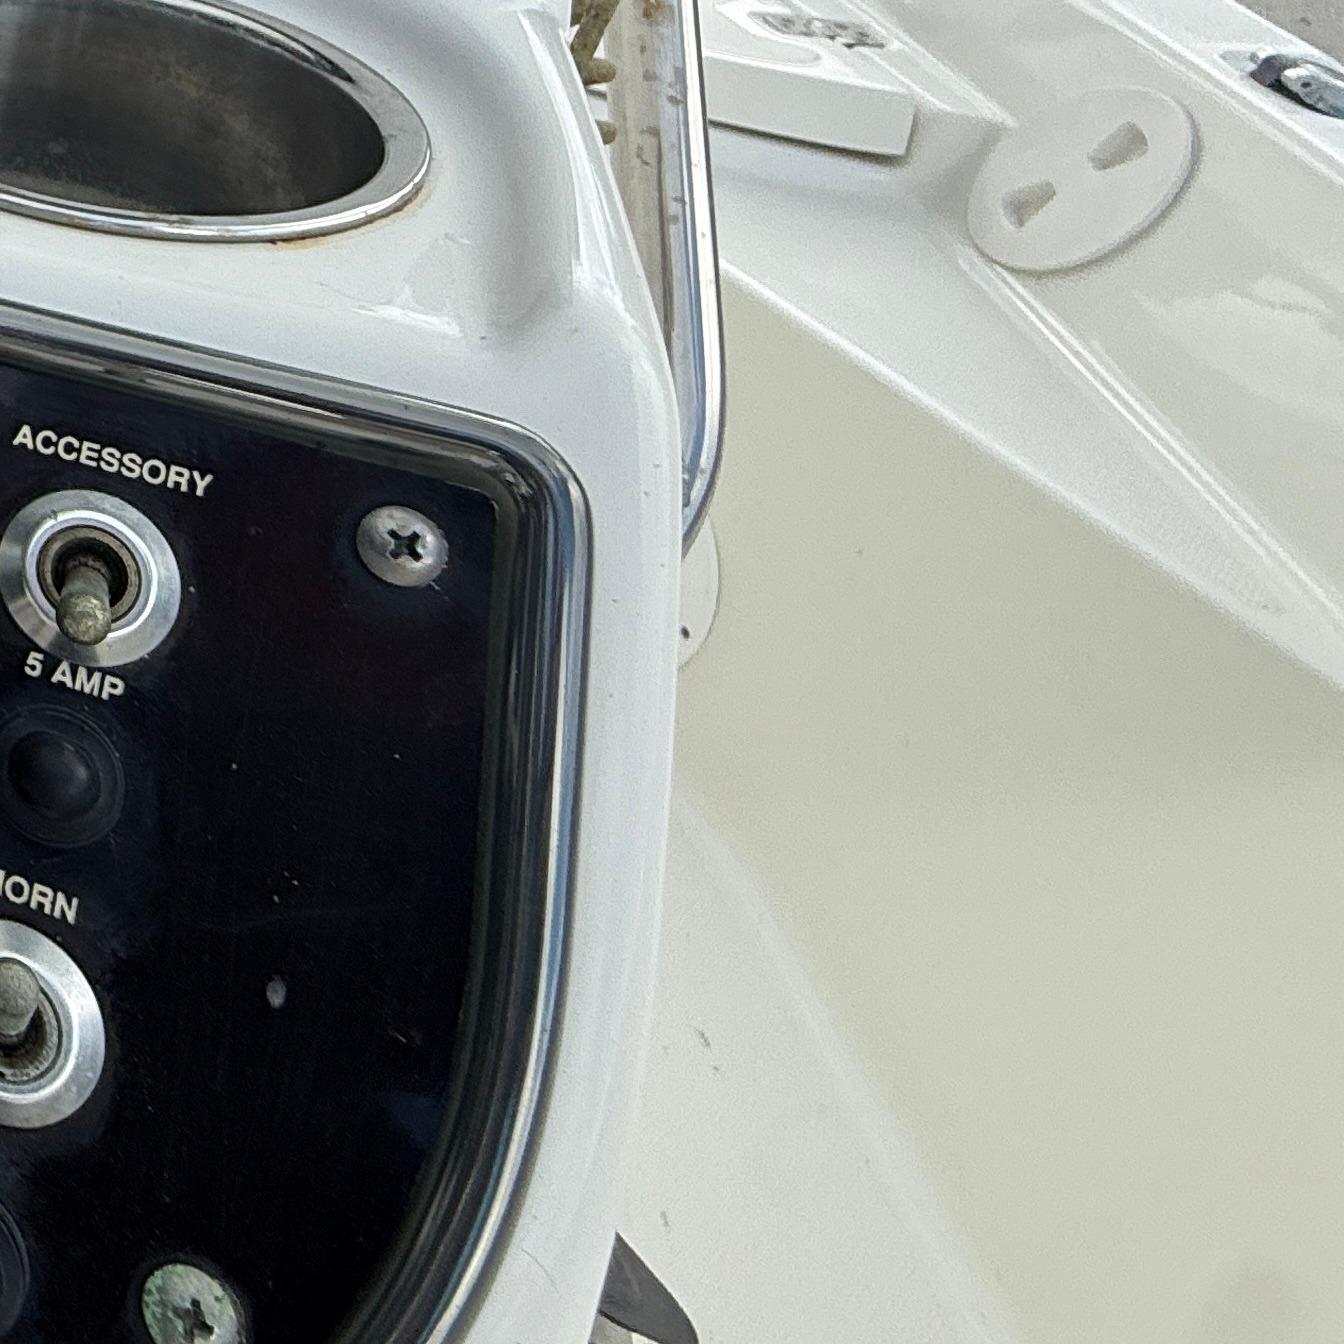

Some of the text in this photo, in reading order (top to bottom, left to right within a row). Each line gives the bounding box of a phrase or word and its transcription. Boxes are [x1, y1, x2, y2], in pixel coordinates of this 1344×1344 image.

[12, 424, 214, 498] ACCESSORY
[24, 651, 125, 702] 5 AMP
